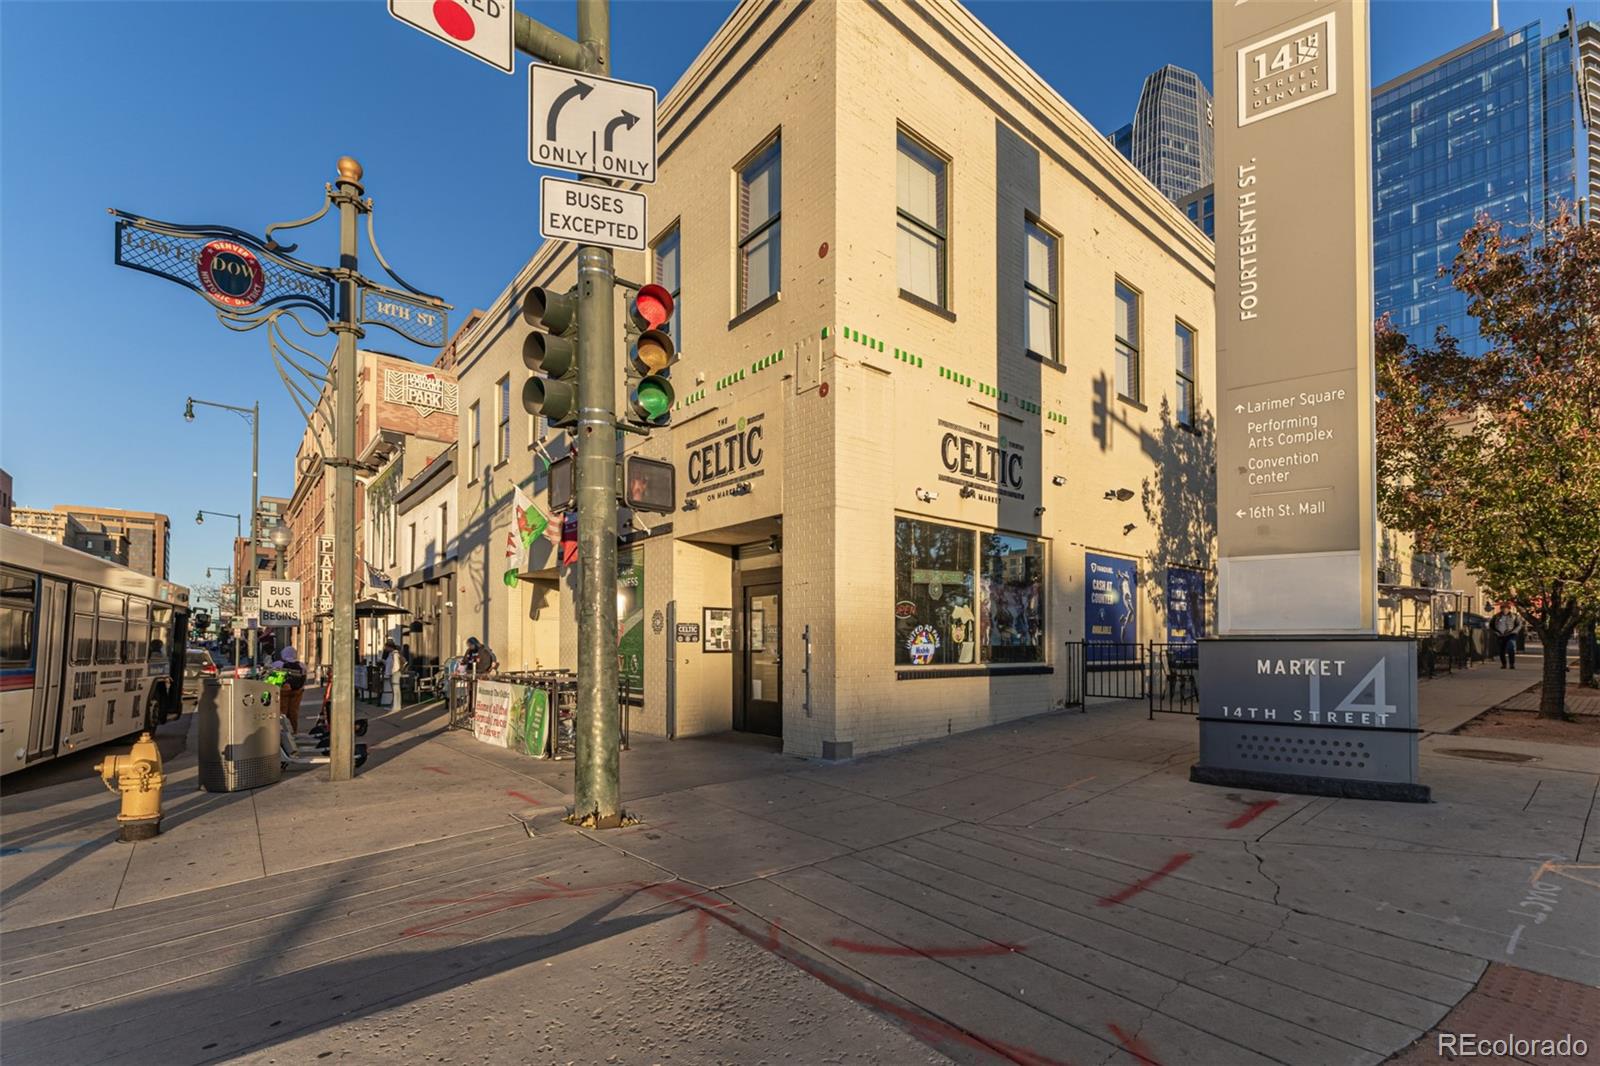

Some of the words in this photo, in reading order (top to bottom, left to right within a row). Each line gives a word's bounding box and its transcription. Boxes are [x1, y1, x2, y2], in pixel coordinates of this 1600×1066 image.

[1254, 33, 1318, 80] 14TH
[1254, 66, 1318, 95] STREET
[1254, 80, 1318, 109] DENVER
[539, 144, 587, 166] ONLY
[602, 156, 649, 177] ONLY
[1238, 158, 1256, 189] ST.
[565, 190, 624, 214] BUSES
[549, 213, 638, 241] EXCEPTED
[214, 243, 249, 258] DENVER
[1239, 192, 1257, 321] FOURTEENTH
[376, 302, 410, 320] 14TH
[416, 313, 436, 327] ST
[408, 388, 442, 407] PARK
[1247, 396, 1296, 414] Larimer
[1299, 388, 1346, 406] Square
[717, 417, 728, 427] THE
[979, 421, 990, 431] THE
[1247, 415, 1318, 434] Performing
[1248, 435, 1274, 449] Arts
[1277, 428, 1334, 445] Complex
[688, 424, 763, 486] CELTIC
[941, 432, 1023, 490] CELTIC
[1248, 452, 1319, 470] Convention
[1248, 471, 1290, 485] Center
[707, 494, 715, 502] ON
[978, 494, 1002, 504] MARKET
[1250, 504, 1274, 519] 16th
[1278, 504, 1295, 516] St.
[1299, 501, 1325, 515] Mall
[270, 586, 291, 596] BUS
[267, 599, 294, 608] LANE
[263, 611, 298, 621] BEGINS
[907, 625, 924, 650] UNITED
[924, 624, 933, 632] AS
[1257, 659, 1346, 676] MARKET
[1222, 706, 1276, 720] 14TH
[1293, 709, 1389, 726] STREET
